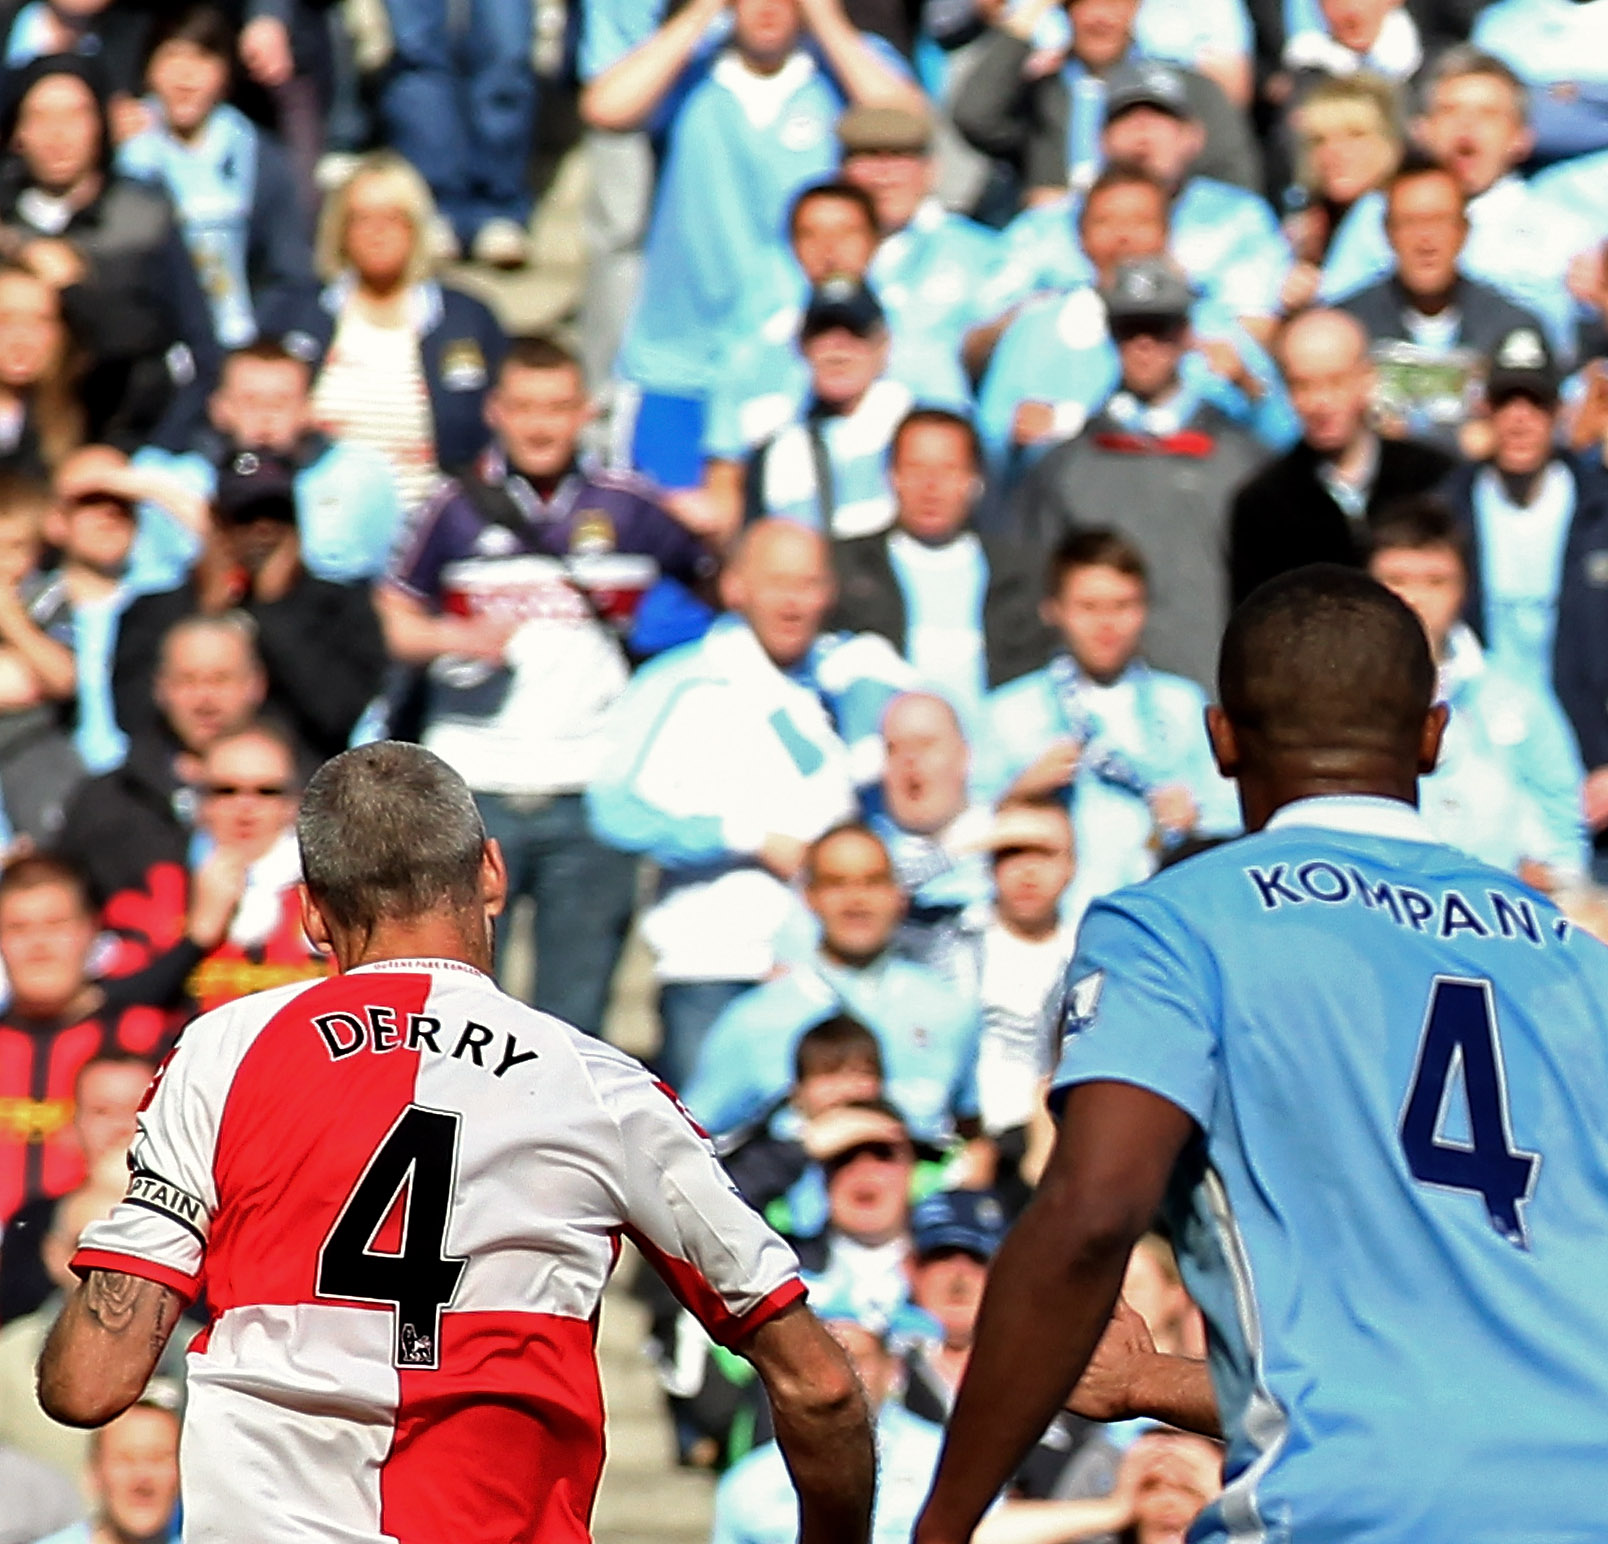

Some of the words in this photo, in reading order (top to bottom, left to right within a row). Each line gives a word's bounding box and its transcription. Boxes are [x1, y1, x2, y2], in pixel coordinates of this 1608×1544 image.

[1243, 861, 1572, 946] KOMPAN
[311, 1005, 539, 1079] DERRY
[1398, 975, 1542, 1252] 4
[131, 1180, 200, 1221] PTAIN
[315, 1103, 471, 1370] 4
